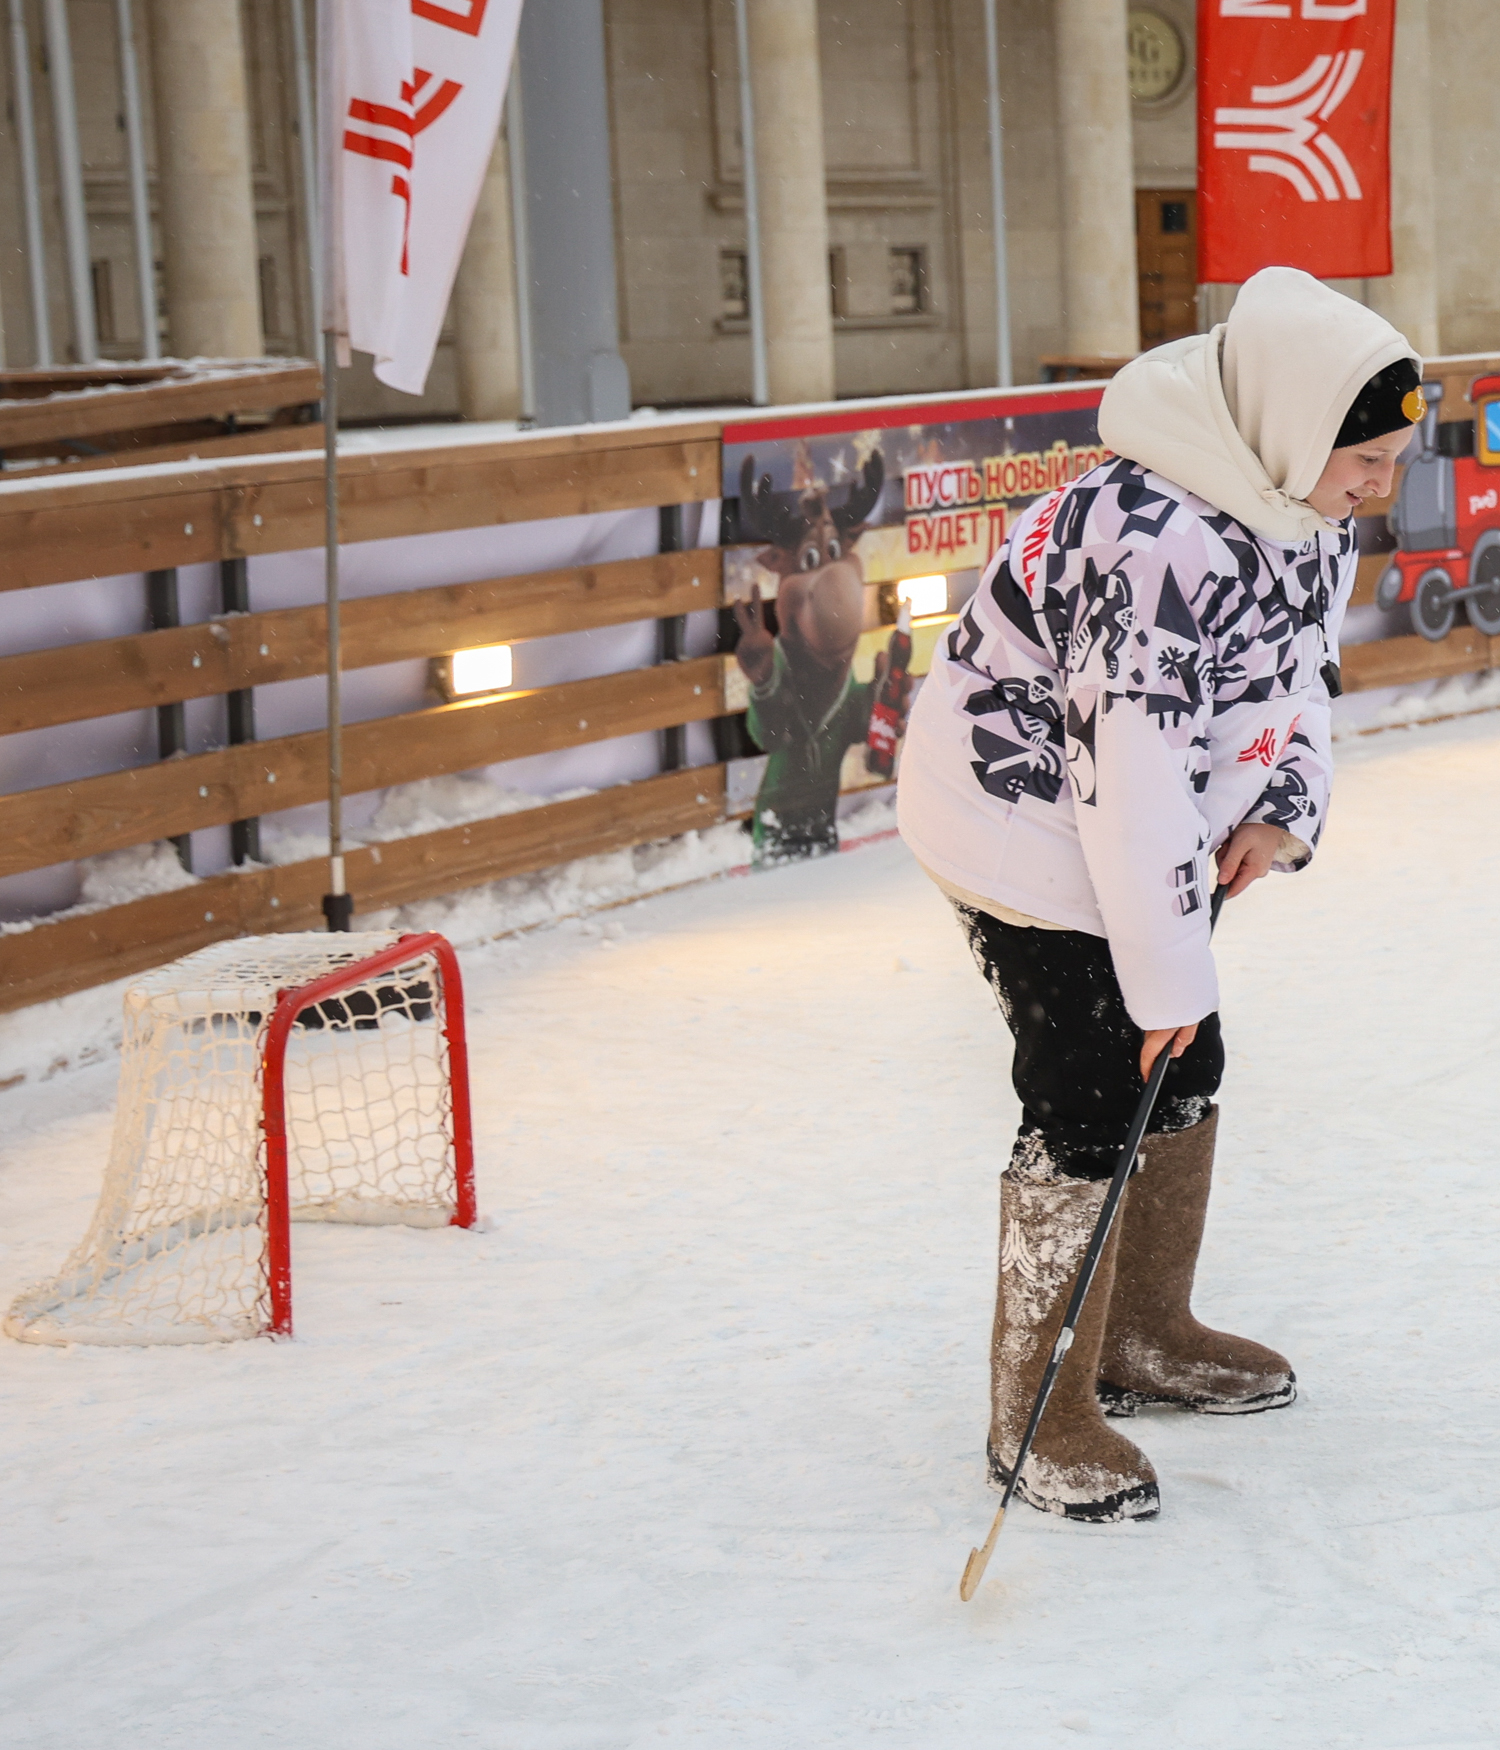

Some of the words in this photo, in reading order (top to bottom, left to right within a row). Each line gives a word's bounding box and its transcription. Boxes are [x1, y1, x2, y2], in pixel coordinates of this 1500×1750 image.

[906, 467, 981, 508] ПУСТЬ
[985, 446, 1068, 499] НОВЫЙ
[1074, 450, 1116, 481] ГО
[907, 511, 982, 556] БУДЕТ
